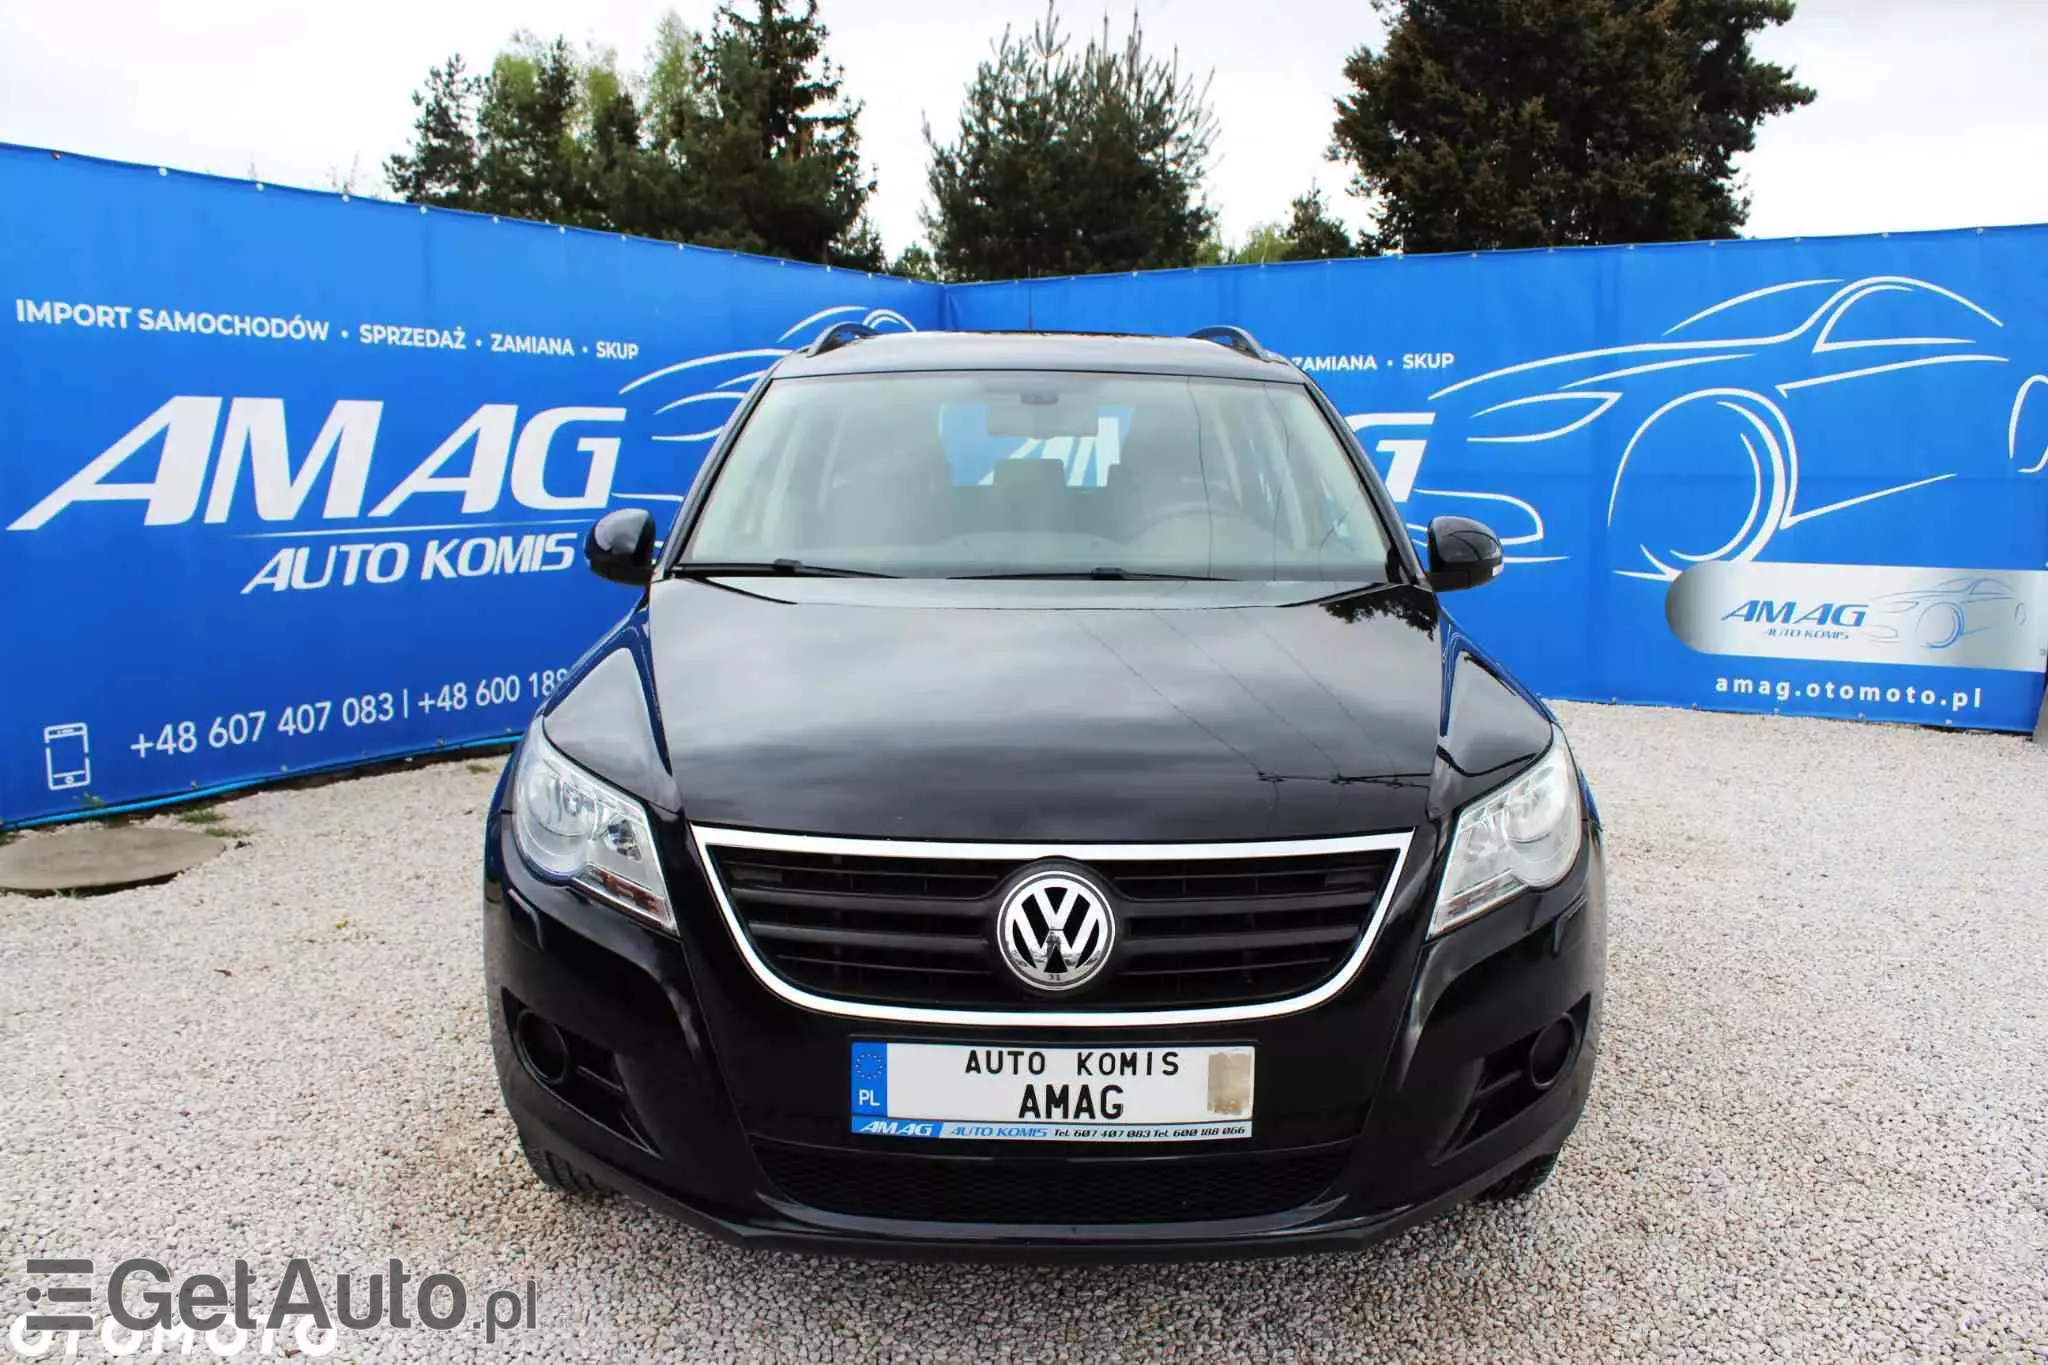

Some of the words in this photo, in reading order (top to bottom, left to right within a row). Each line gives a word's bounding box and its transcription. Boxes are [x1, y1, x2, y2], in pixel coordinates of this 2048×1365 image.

[15, 298, 132, 330] IMPORT
[138, 308, 330, 342] SAMOCHODÓW
[359, 324, 467, 350] SPRZEDAŻ
[490, 333, 576, 357] ZAMIANA
[596, 341, 639, 360] SKUP
[1402, 352, 1455, 369] SKUP
[240, 542, 409, 594] AUTO
[420, 532, 578, 581] KOMIS
[418, 682, 468, 714] +48
[475, 675, 521, 706] 600
[1715, 677, 1982, 711] amag.otomoto.pl
[130, 720, 198, 758] +48
[208, 710, 266, 748] 607
[277, 701, 332, 736] 407
[342, 692, 395, 727] 083
[964, 1050, 1046, 1076] AUTO
[1076, 1051, 1179, 1076] KOMIS
[859, 1089, 881, 1107] PL
[1018, 1084, 1124, 1120] AMAG
[952, 1126, 992, 1137] AUTO
[995, 1127, 1048, 1138] KOMIS
